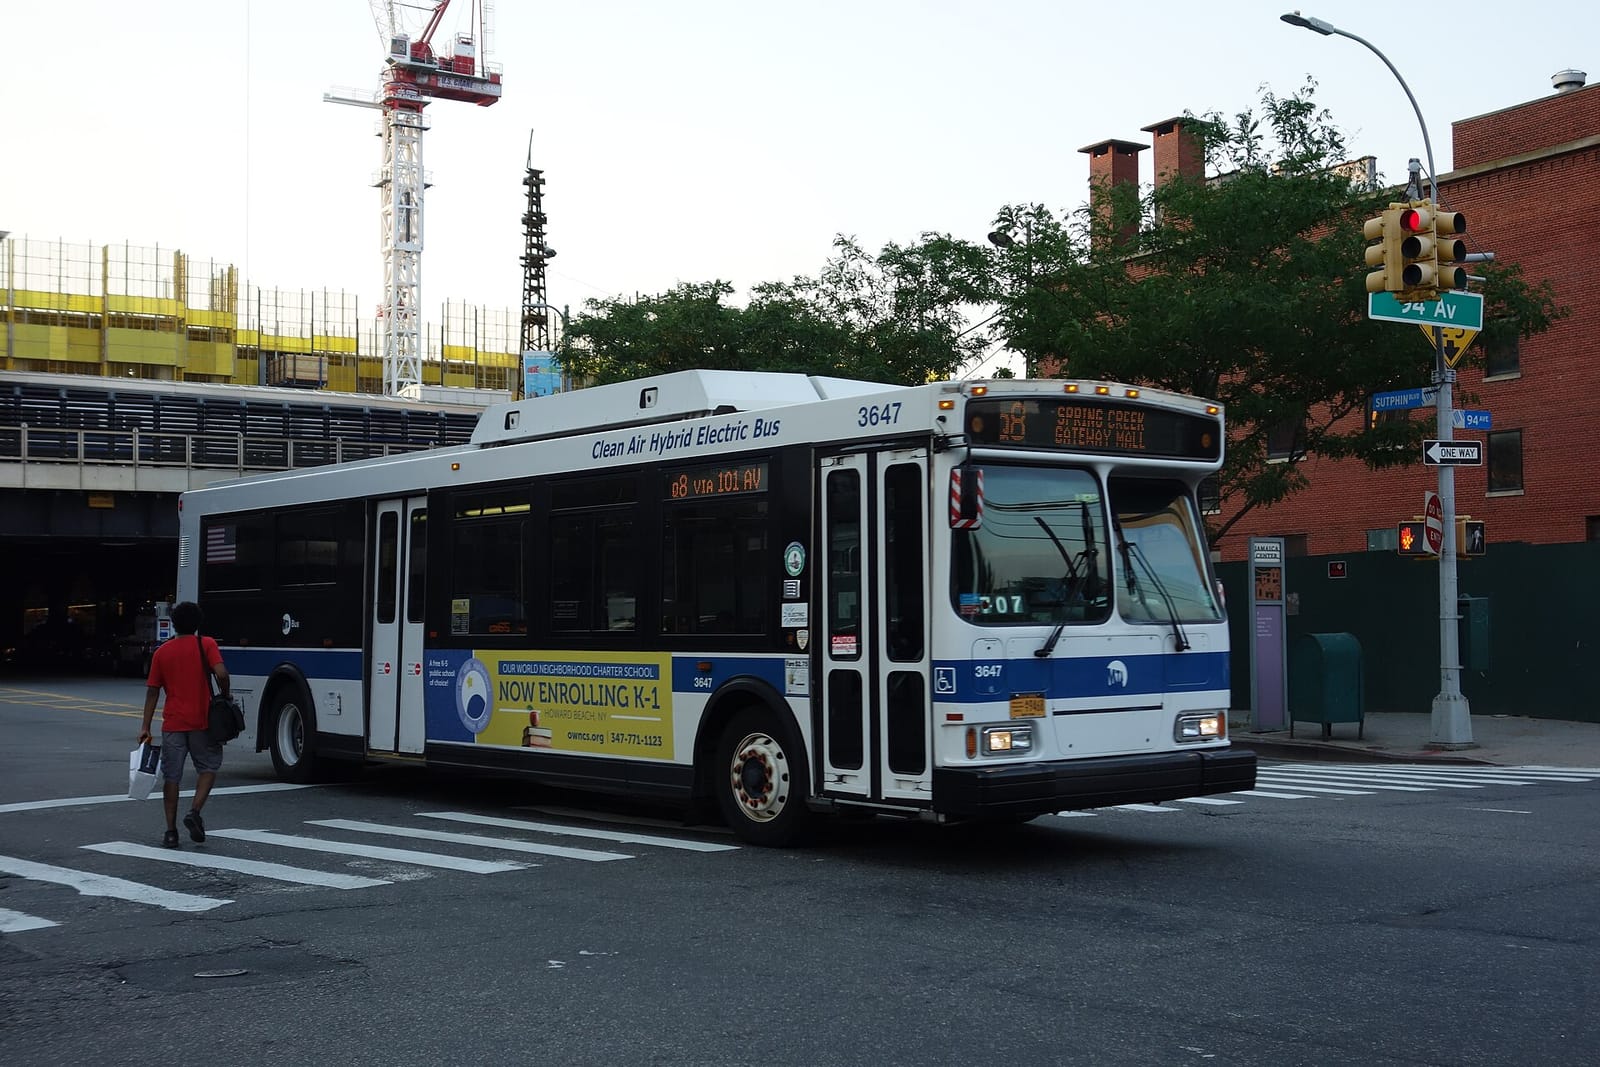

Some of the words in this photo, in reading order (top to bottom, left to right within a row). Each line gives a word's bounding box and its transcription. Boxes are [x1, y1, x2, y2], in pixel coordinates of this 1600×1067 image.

[1433, 298, 1457, 319] Av
[1375, 396, 1409, 408] SUTPHIN
[857, 402, 902, 427] 3647
[1056, 406, 1103, 427] SPRING
[1107, 409, 1145, 430] CREEK
[1466, 414, 1479, 425] 94
[1479, 415, 1489, 423] AVE
[592, 440, 624, 459] Clean
[627, 434, 645, 455] Air
[649, 427, 692, 456] Hybrid
[696, 420, 749, 445] Electric
[753, 417, 780, 438] Bus
[1055, 426, 1112, 446] GATEWAY
[1115, 431, 1145, 449] MALL
[1440, 448, 1456, 457] ONE
[1459, 448, 1475, 457] WAY
[671, 474, 688, 498] Q8
[693, 479, 714, 494] VIA
[717, 470, 739, 493] 101
[743, 467, 761, 490] AV
[502, 664, 517, 673] OUR
[517, 664, 538, 674] WORLD
[539, 664, 592, 676] NEIGHBORHOOD
[593, 665, 623, 677] CHARTER
[624, 667, 654, 678] SCHOOL
[974, 665, 1003, 677] 3647
[694, 676, 713, 688] 3647
[499, 681, 535, 701] NOW
[538, 682, 628, 708] ENROLLING
[633, 686, 660, 710] K-1
[544, 709, 572, 720] HOWARD
[597, 711, 607, 721] NY
[567, 730, 604, 745] owncs.org
[611, 732, 663, 747] 347-771-1123
